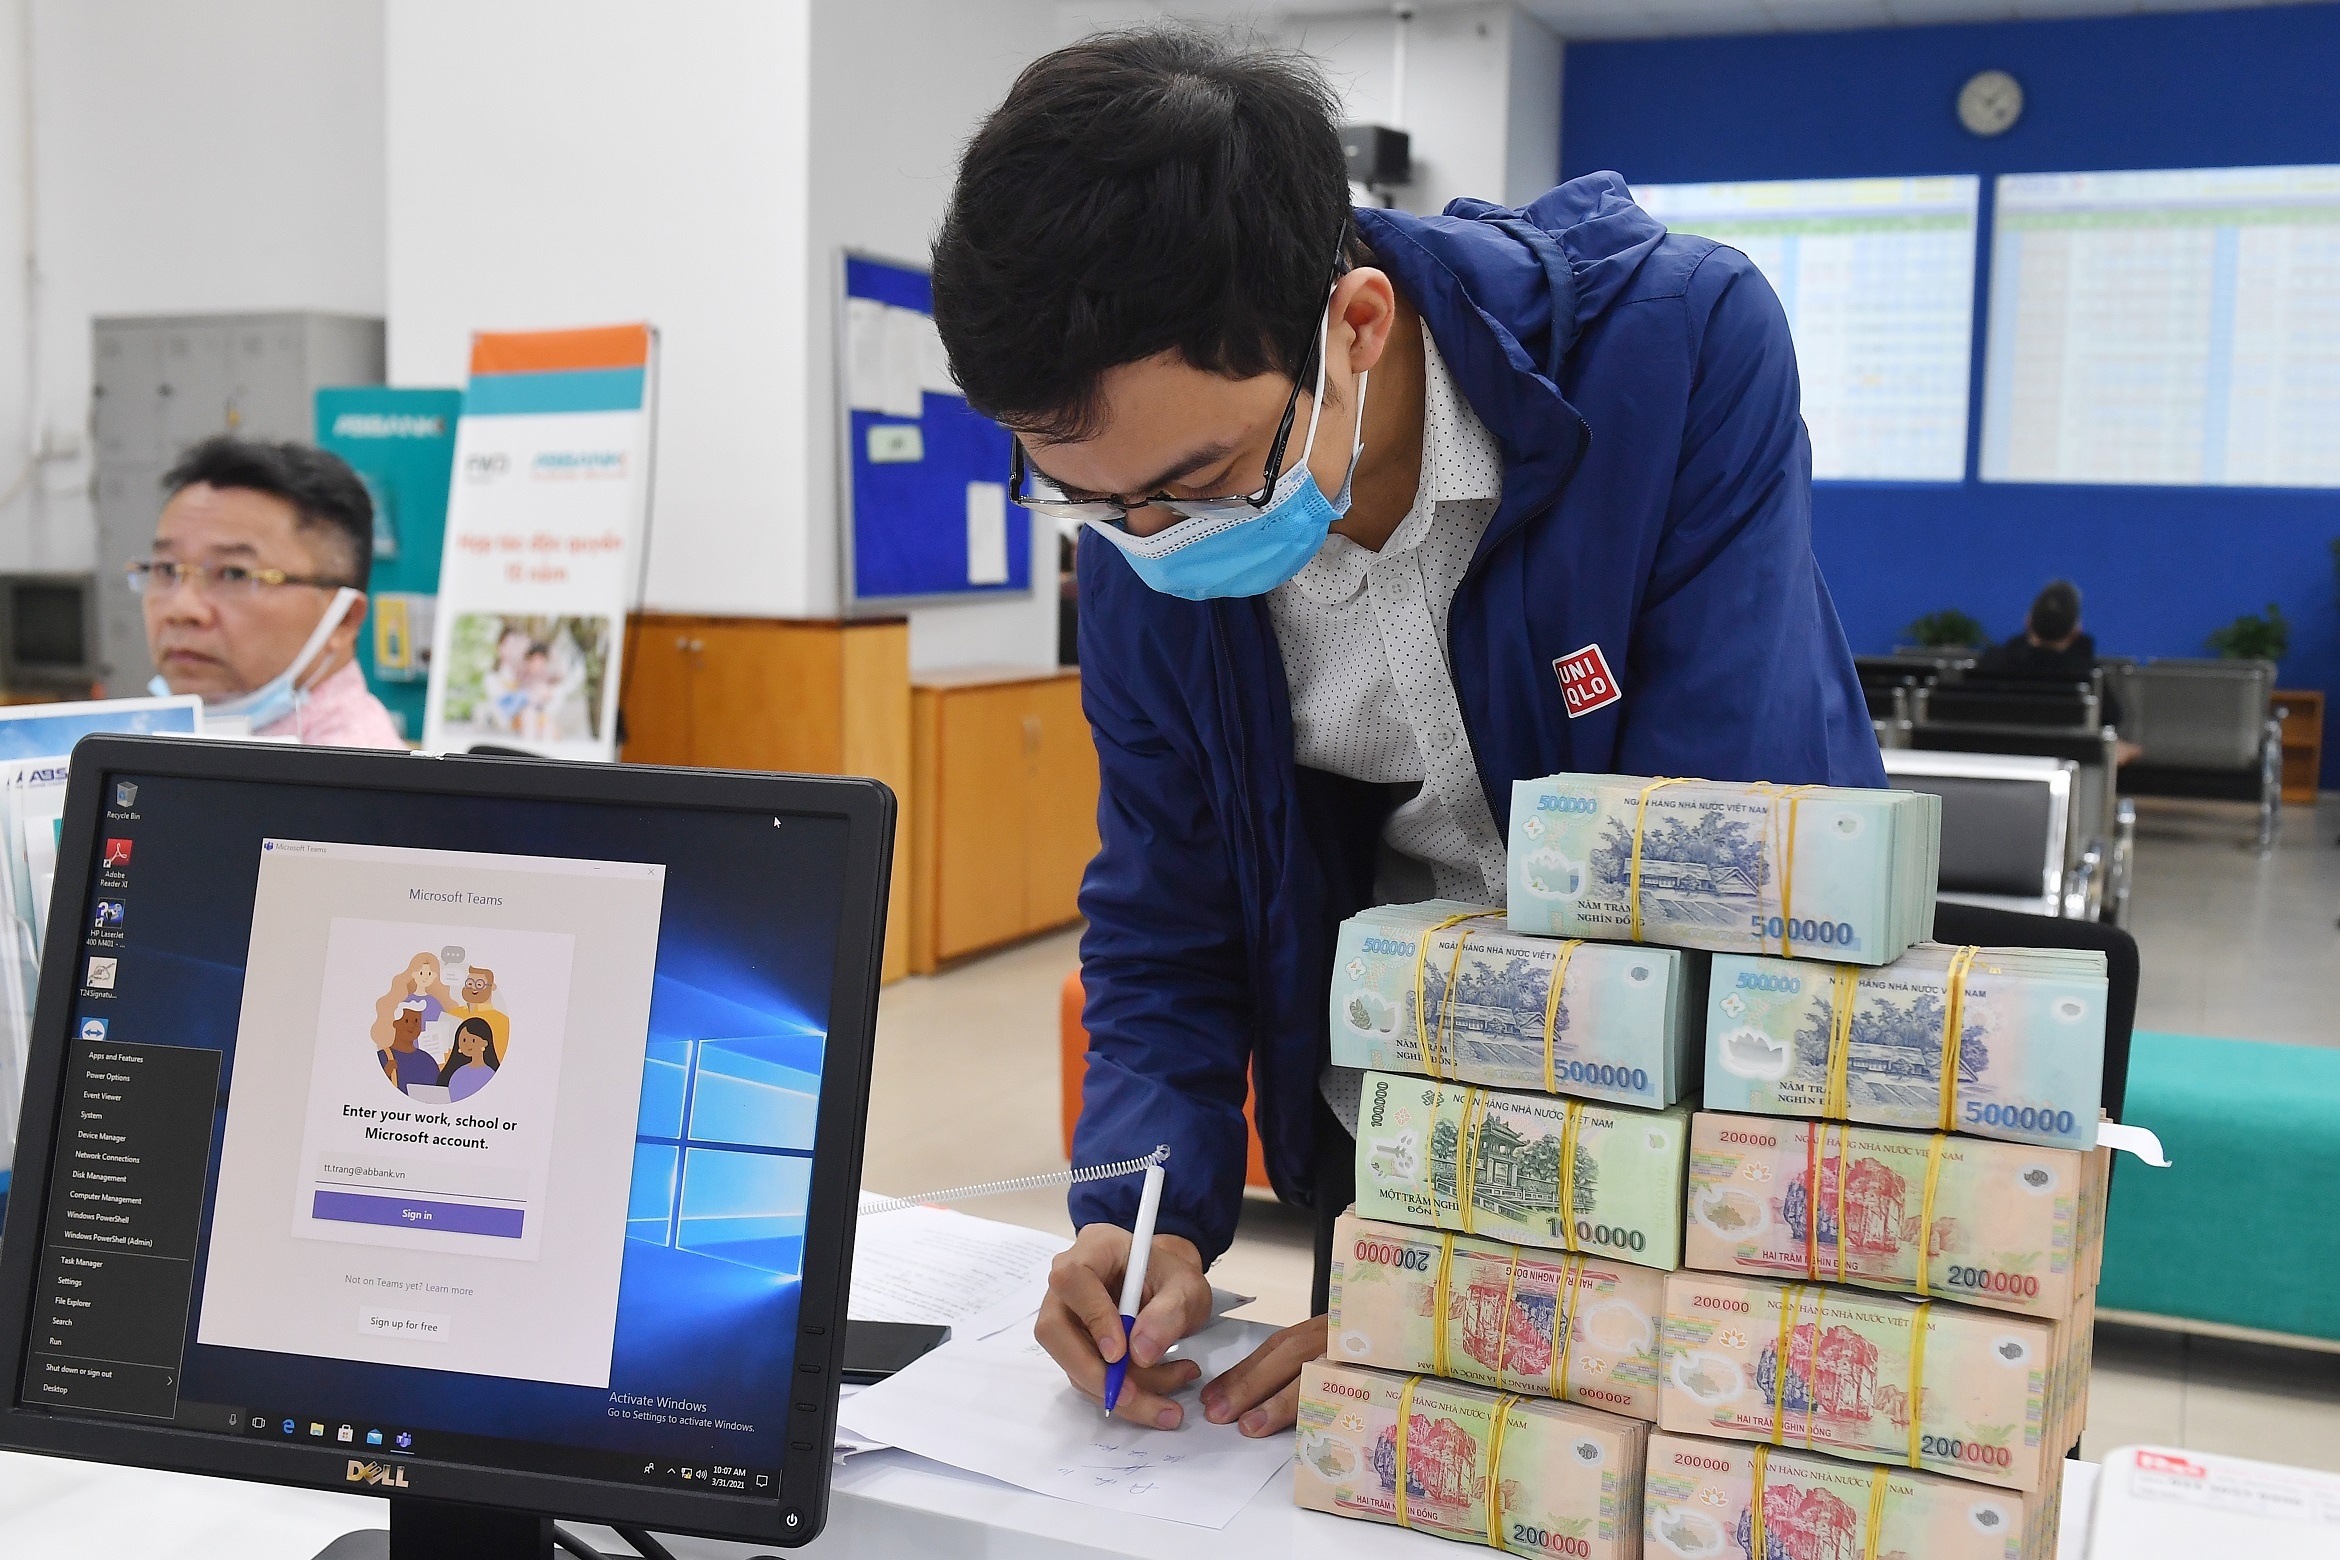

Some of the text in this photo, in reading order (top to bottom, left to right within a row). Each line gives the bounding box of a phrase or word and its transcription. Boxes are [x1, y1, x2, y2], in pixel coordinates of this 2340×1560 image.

[1559, 657, 1595, 684] UNI
[1566, 676, 1607, 707] QLO
[106, 810, 141, 821] Recycle Bin
[275, 842, 327, 853] Microsoft Teams
[105, 870, 126, 879] Adobe
[100, 879, 129, 889] Reader XI
[409, 888, 503, 906] Microsoft Teams
[90, 929, 124, 939] HP LaserJet
[86, 938, 97, 946] 400
[88, 1051, 144, 1063] Apps and Features
[86, 1070, 131, 1082] Power Options
[83, 1090, 122, 1101] Event Viewer
[80, 1110, 103, 1120] System
[342, 1104, 518, 1132] Enter your work, school or
[1591, 1117, 1614, 1129] NAM
[77, 1130, 127, 1143] Device Manager
[365, 1126, 489, 1150] Microsoft account.
[75, 1150, 140, 1164] Network Connections
[72, 1170, 127, 1183] Disk Management
[323, 1163, 406, 1180] tt.trang@abbank.vn
[69, 1190, 142, 1205] Computer Management
[67, 1210, 130, 1224] Windows PowerShell
[401, 1208, 433, 1222] Sign in
[64, 1230, 153, 1248] Windows PowerShell (Admin)
[1546, 1216, 1647, 1252] 10.000
[1762, 1250, 1777, 1260] HAI
[60, 1256, 103, 1269] Task Manager
[57, 1276, 82, 1287] Settings
[344, 1274, 474, 1297] Not on Teams yet? Learn more
[55, 1296, 91, 1309] File Explorer
[52, 1316, 73, 1326] Search
[370, 1316, 439, 1332] Sign up for free
[49, 1337, 62, 1346] Run
[45, 1363, 60, 1372] Shut
[61, 1364, 78, 1374] down
[87, 1368, 101, 1378] sign
[101, 1370, 113, 1378] out
[43, 1383, 68, 1395] Desktop
[608, 1391, 708, 1413] Activate Windows
[607, 1407, 755, 1433] Go to Settings to activate Windows.
[1506, 1418, 1528, 1430] NAM
[1736, 1414, 1751, 1424] HAI
[346, 1460, 409, 1488] DELL
[713, 1465, 747, 1477] 10:07 AM
[711, 1477, 745, 1490] 3/31/2021
[1889, 1484, 1915, 1496] NAM
[1356, 1495, 1369, 1505] HAI
